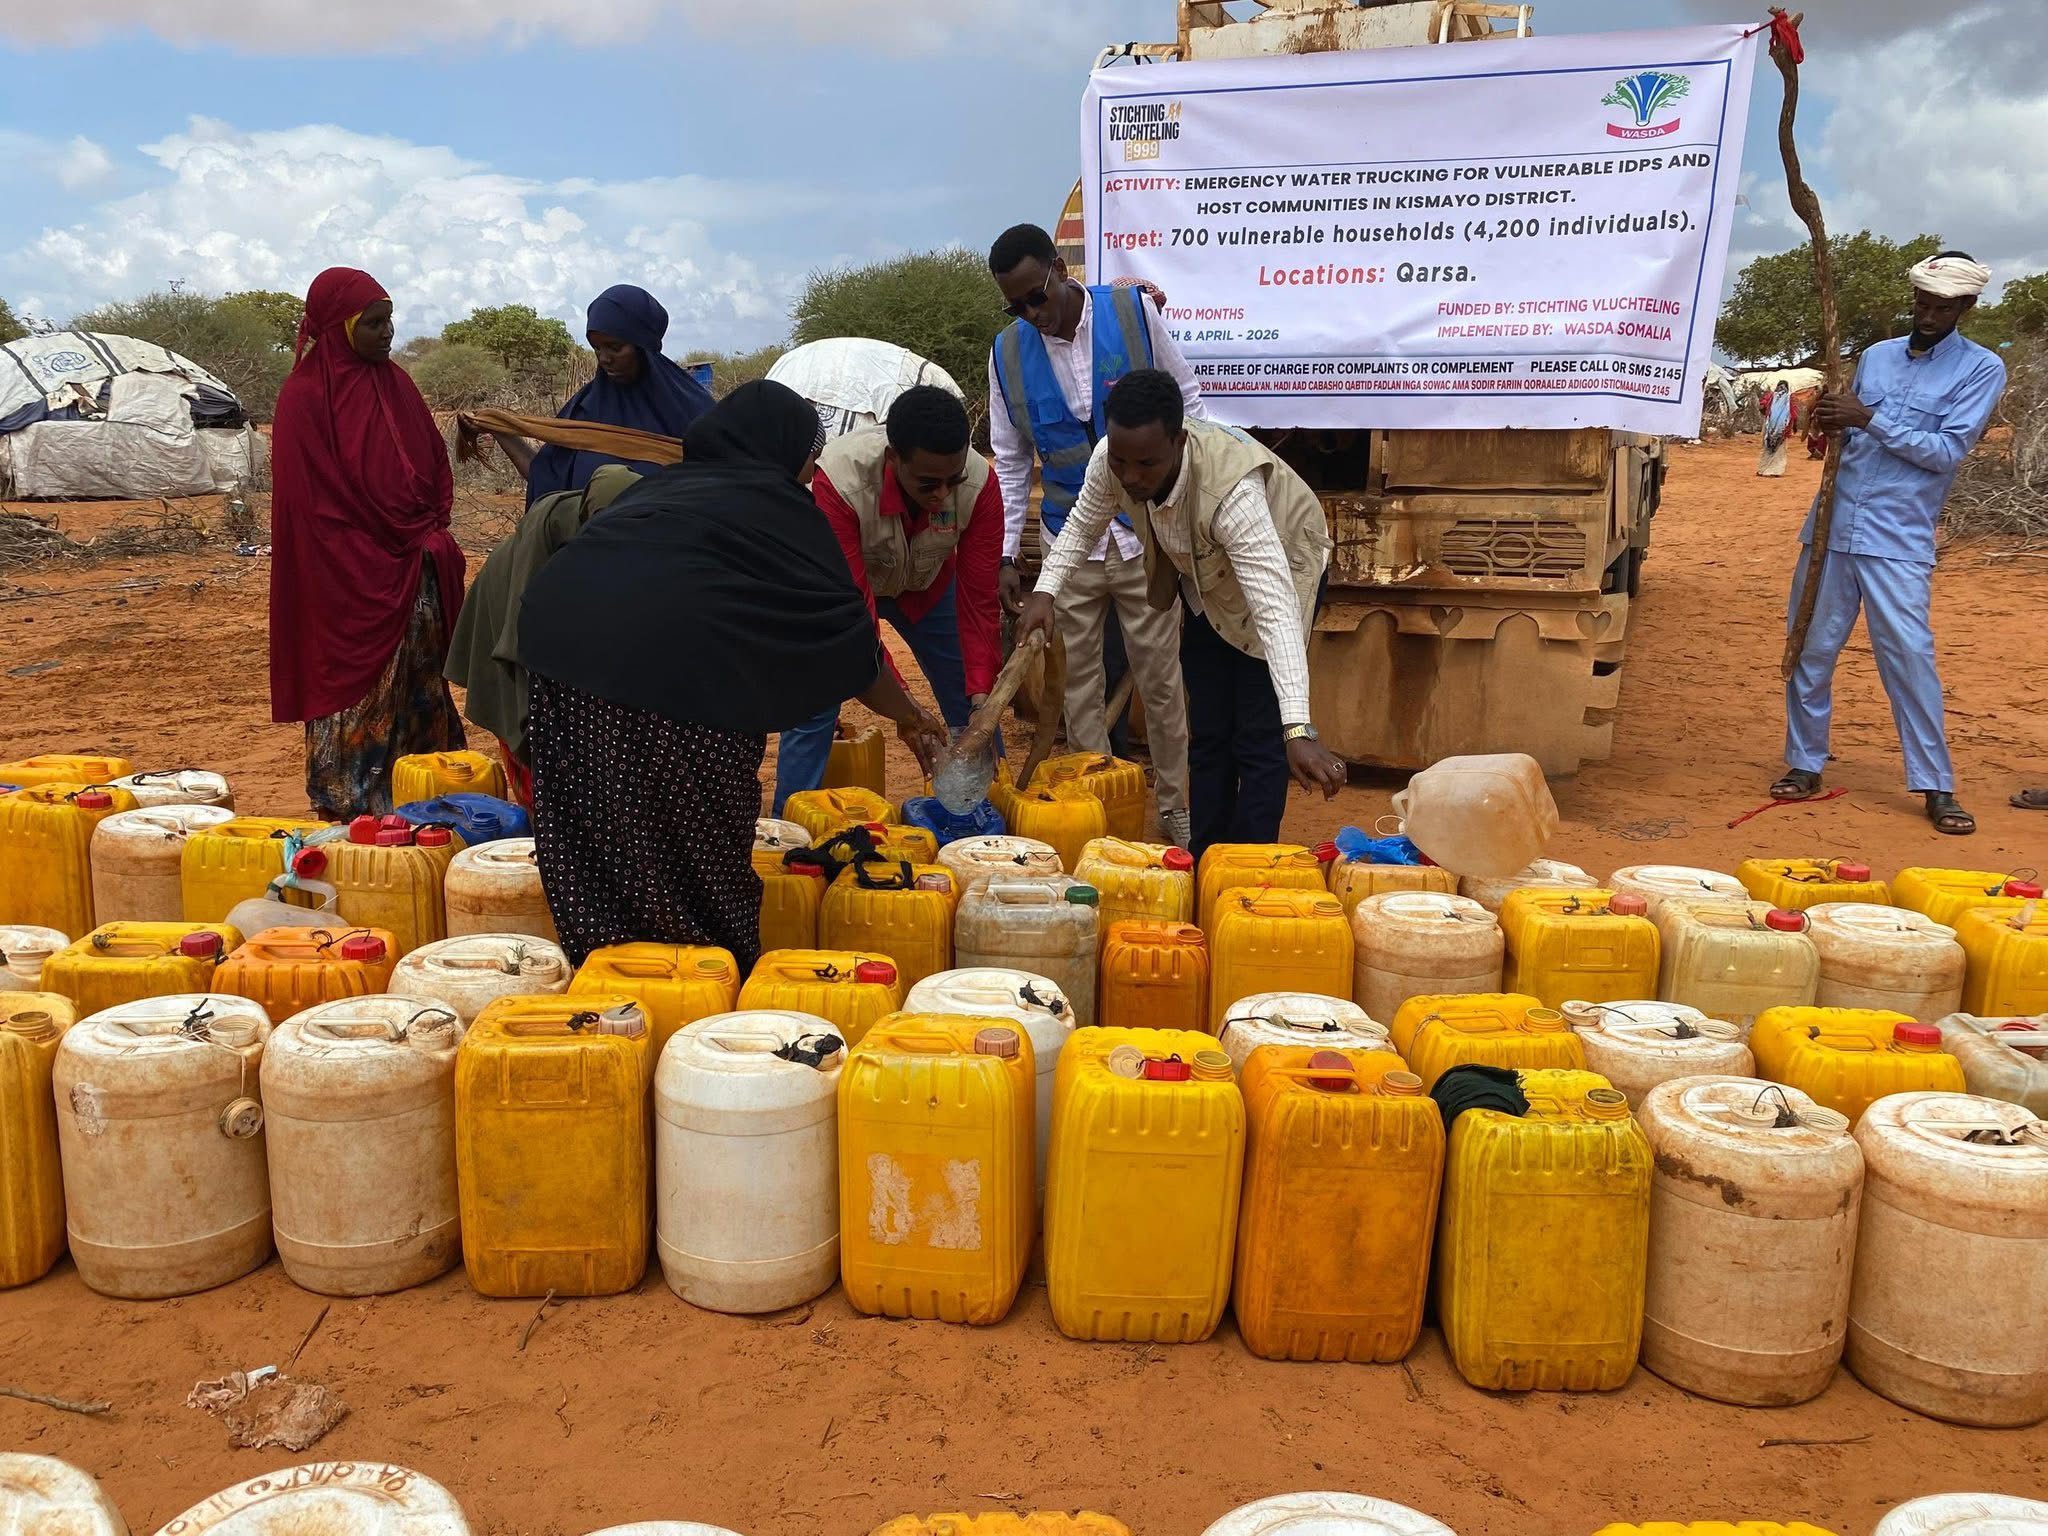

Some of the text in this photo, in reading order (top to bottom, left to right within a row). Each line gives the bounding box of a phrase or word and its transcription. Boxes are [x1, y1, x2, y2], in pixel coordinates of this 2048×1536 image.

[1110, 104, 1165, 123] STICHTING
[1110, 122, 1180, 141] VLUCHTELING
[1621, 128, 1665, 139] WASDA
[1133, 142, 1158, 158] 999
[1106, 153, 1711, 193] ACTIVITY: EMERGENCY WATER TRUCKING FOR VULNERABLE IDPS AND
[1197, 189, 1576, 215] HOST COMMUNITIES IN KISMAYO DISTRICT.
[1104, 210, 1696, 250] Target: 700 vulnerable households (4,200 individuals).
[1259, 262, 1476, 286] Locations: Qarsa.
[1165, 308, 1244, 320] TWO MONTHS
[1438, 297, 1680, 315] FUNDED BY: STICHTING VLUCHTELING
[1184, 330, 1191, 341] &
[1196, 330, 1233, 340] APRIL
[1246, 330, 1279, 340] 2026
[1438, 321, 1671, 341] IMPLEMENTED BY: WASDA SOMALIA
[1194, 360, 1681, 380] ARE FREE OF CHARGE FOR COMPLAINTS OR COMPLEMENT PLEASE CALL OR SMS 2145
[1212, 382, 1227, 391] WAA
[1274, 382, 1290, 390] HADI
[1292, 381, 1307, 390] AAD
[1309, 381, 1343, 390] CABASHO
[1345, 381, 1372, 390] QABTID
[1374, 380, 1400, 390] FADLAN
[1403, 380, 1421, 390] INGA
[1423, 380, 1451, 390] SOWAC
[1452, 380, 1469, 390] AMA
[1471, 380, 1495, 390] SODIR
[1497, 380, 1522, 389] FARIIN
[1524, 380, 1566, 390] QORAALED
[1568, 379, 1599, 388] ADIGOO
[1601, 379, 1650, 393] ISTICMAALAYO
[1652, 386, 1670, 396] 2145
